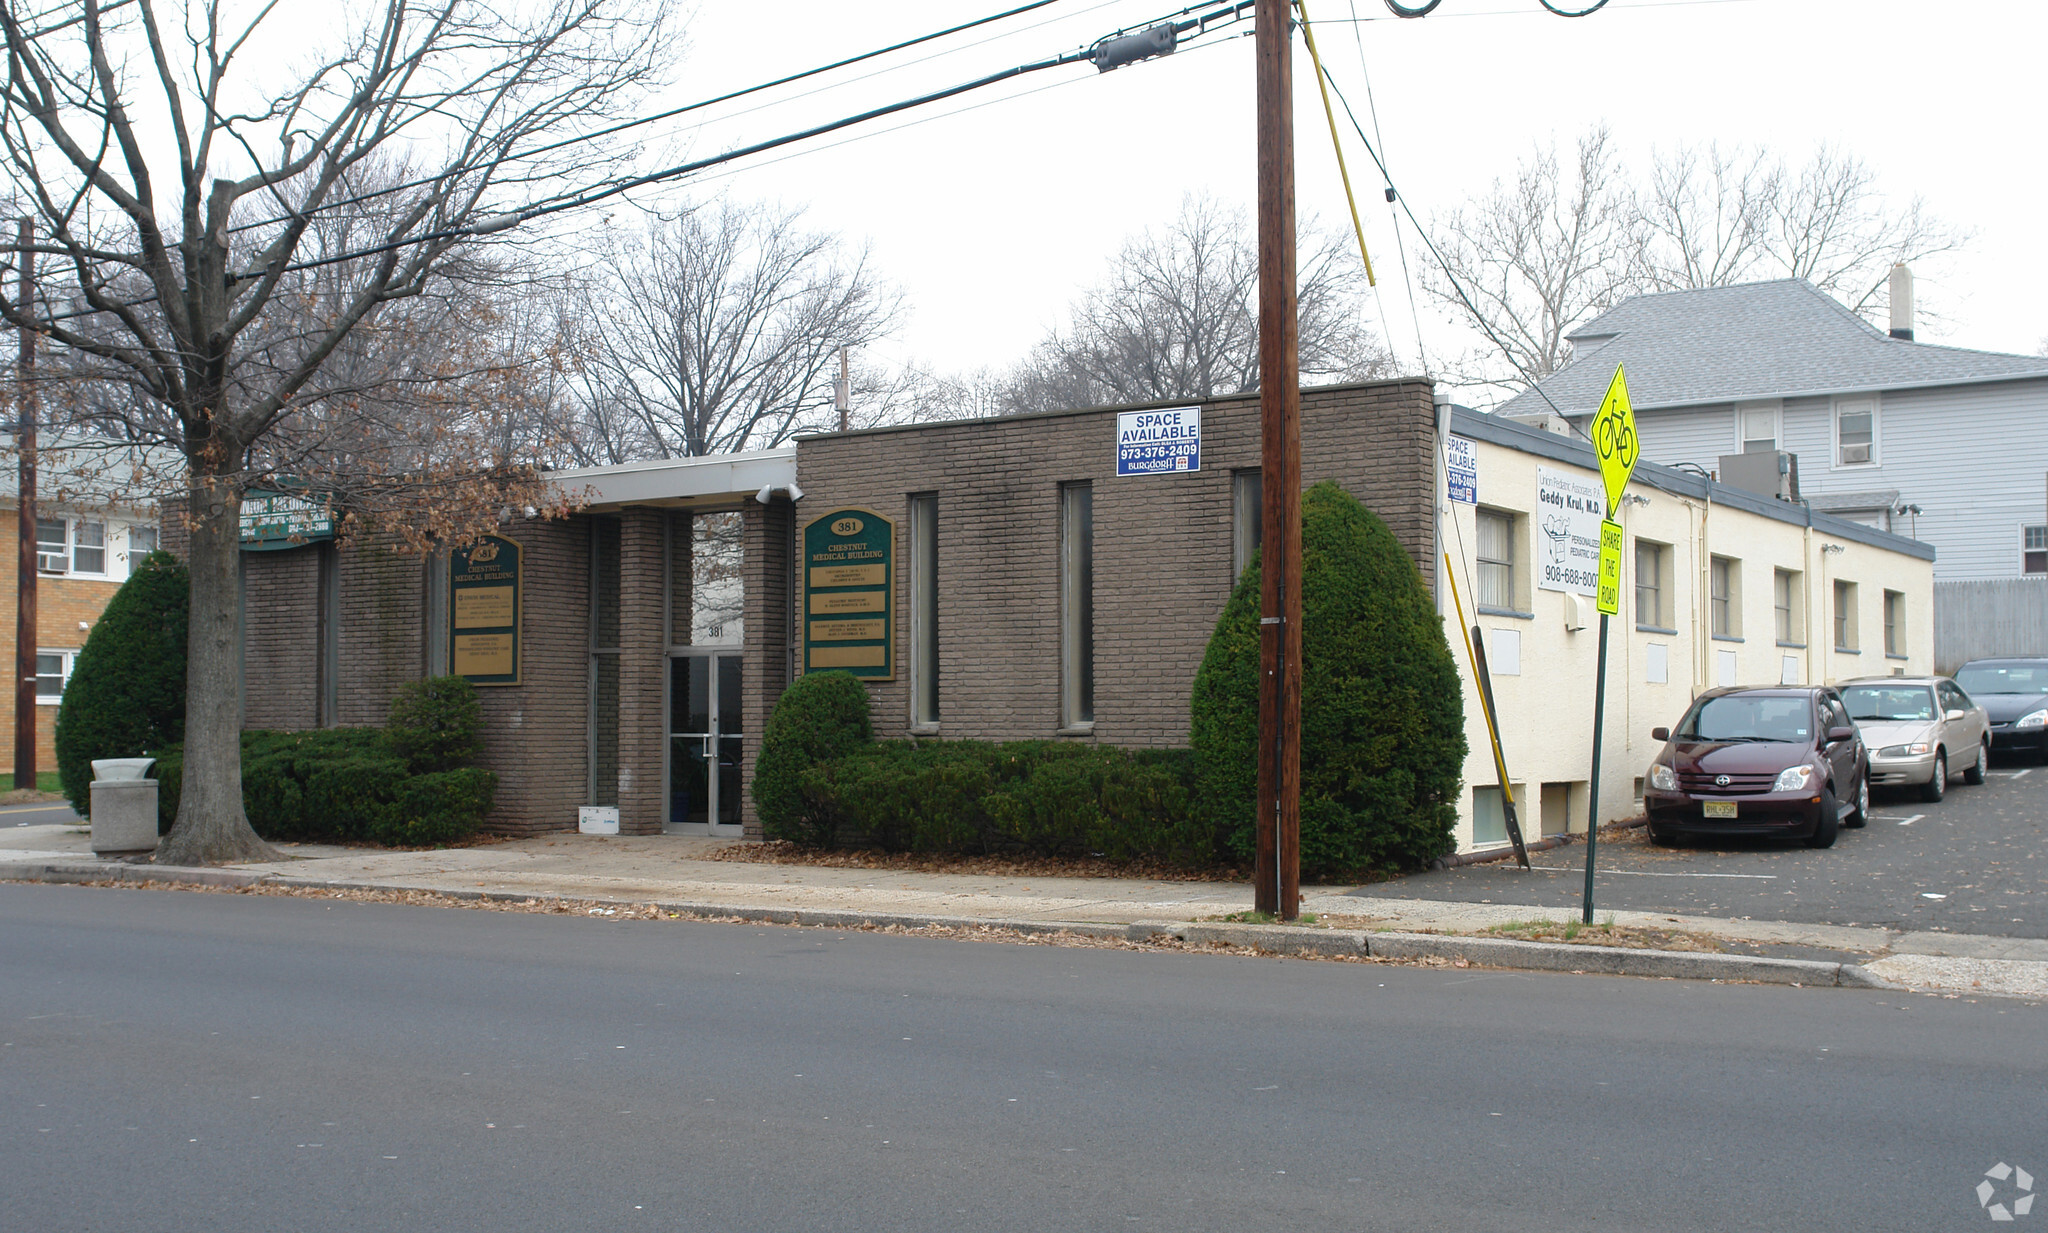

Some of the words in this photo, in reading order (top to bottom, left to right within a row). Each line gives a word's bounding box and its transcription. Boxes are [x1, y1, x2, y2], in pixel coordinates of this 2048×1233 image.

[1136, 412, 1181, 428] SPACE
[1122, 425, 1196, 442] AVAILABLE
[1121, 444, 1197, 460] 973-376-2409
[1448, 438, 1468, 454] SPACE
[1448, 452, 1476, 470] AILABLE
[1540, 474, 1552, 487] Union
[1540, 488, 1564, 509] Geddy
[1566, 494, 1584, 514] Krul,
[1586, 499, 1602, 516] M.D.
[838, 522, 856, 532] 381
[828, 543, 868, 552] CHESTNUT
[1603, 530, 1620, 550] SHARE
[812, 552, 846, 561] MEDICAL
[848, 550, 883, 560] BUILDING
[1570, 546, 1590, 558] PEDIATRIC
[468, 564, 502, 573] CHESTNUT
[1606, 558, 1616, 578] THE
[455, 574, 482, 582] MEDICAL
[484, 571, 514, 580] BUILDING
[1601, 585, 1616, 604] ROAD
[708, 626, 722, 638] 381
